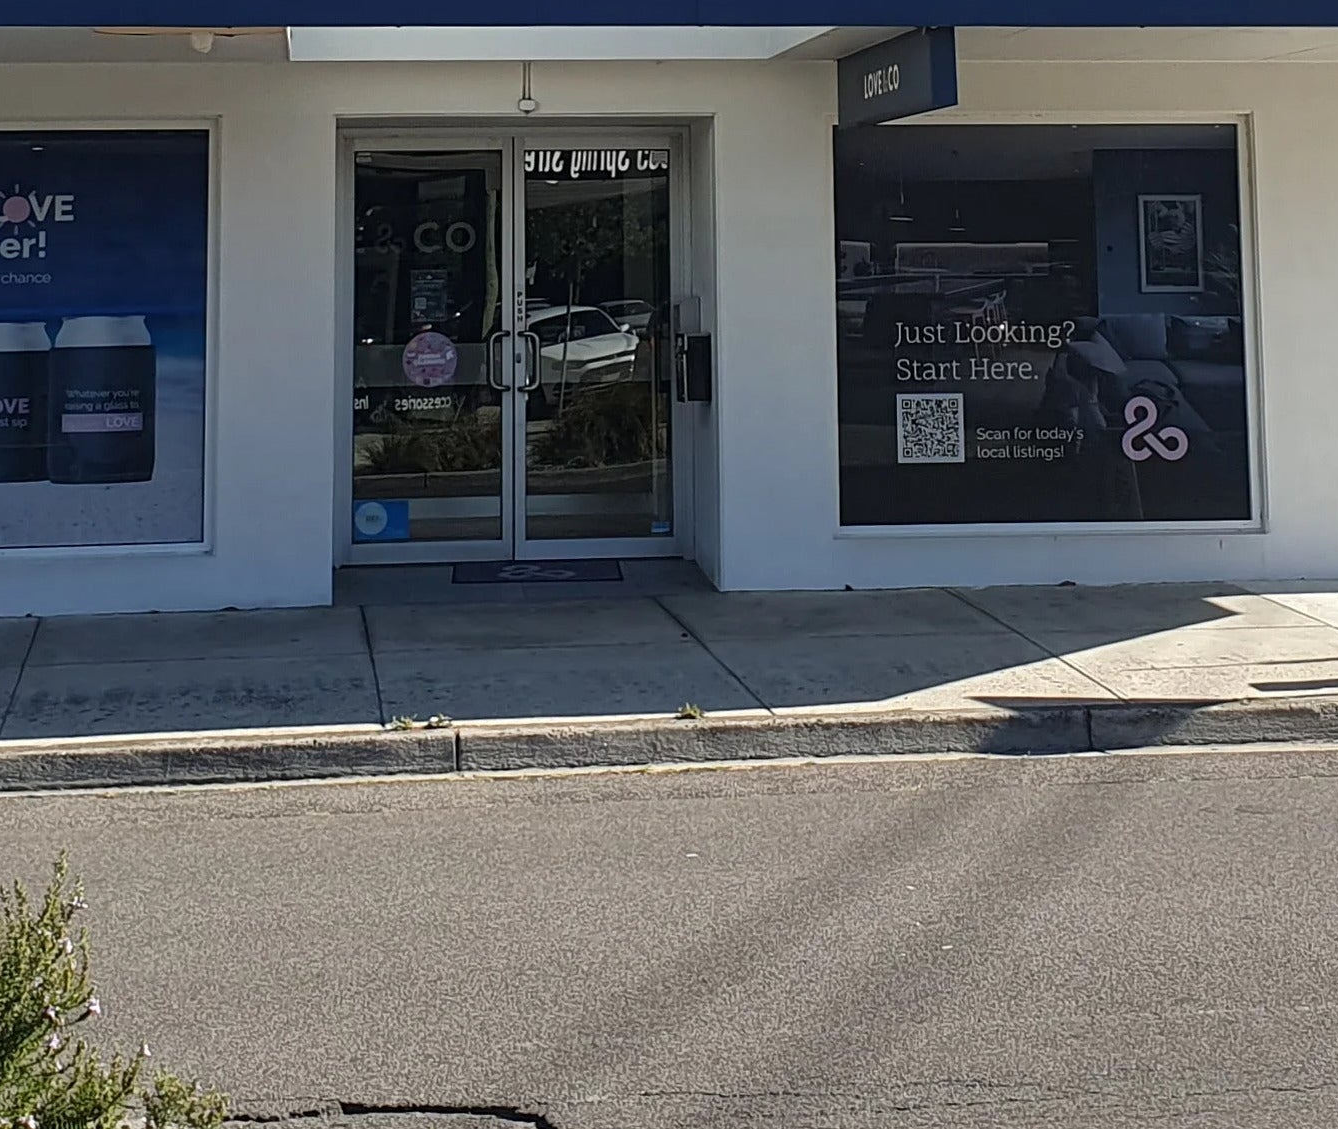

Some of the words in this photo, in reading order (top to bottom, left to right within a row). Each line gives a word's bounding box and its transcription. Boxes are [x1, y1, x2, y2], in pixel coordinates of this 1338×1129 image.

[0, 272, 52, 284] chance
[895, 322, 946, 347] Just
[955, 321, 1075, 348] Looking?
[897, 359, 961, 380] Start
[970, 358, 1039, 380] Here.
[106, 416, 140, 428] LOVE
[976, 428, 1010, 440] Scan
[1014, 427, 1032, 440] for
[1036, 427, 1084, 443] today's
[977, 446, 1010, 458] local
[1014, 445, 1064, 461] listings!
